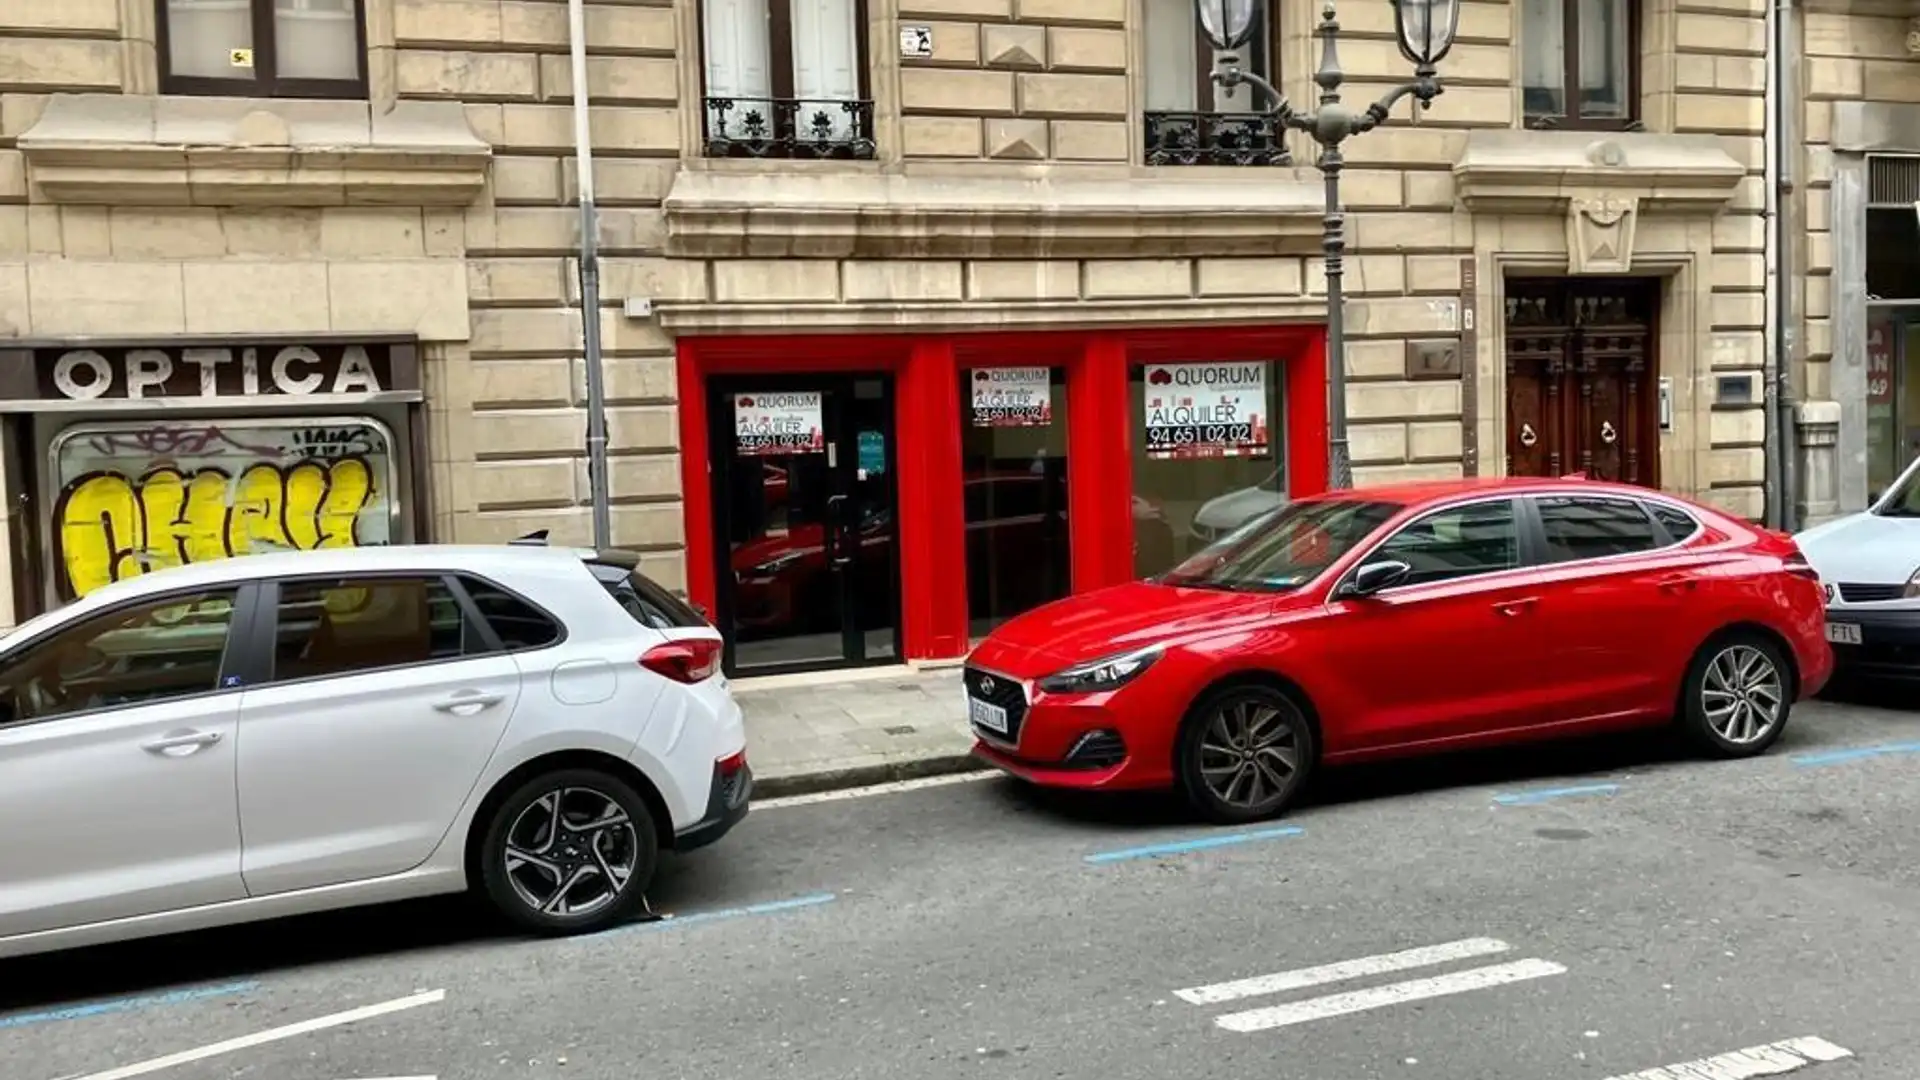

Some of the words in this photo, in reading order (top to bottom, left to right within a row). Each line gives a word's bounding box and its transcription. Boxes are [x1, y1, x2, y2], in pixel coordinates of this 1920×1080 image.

[54, 346, 381, 399] OPTICA
[1175, 366, 1260, 387] QUORUM
[757, 395, 818, 408] QUORUM
[975, 395, 1031, 407] ALQUILER
[1151, 405, 1236, 425] ALQUILER
[740, 421, 802, 434] ALQUILER
[1150, 428, 1170, 443] 94
[1174, 427, 1201, 443] 651
[1206, 425, 1226, 441] 02
[1229, 425, 1249, 440] 02
[740, 435, 755, 447] 94
[756, 434, 777, 448] 651
[780, 433, 795, 446] 02
[796, 432, 812, 447] 02
